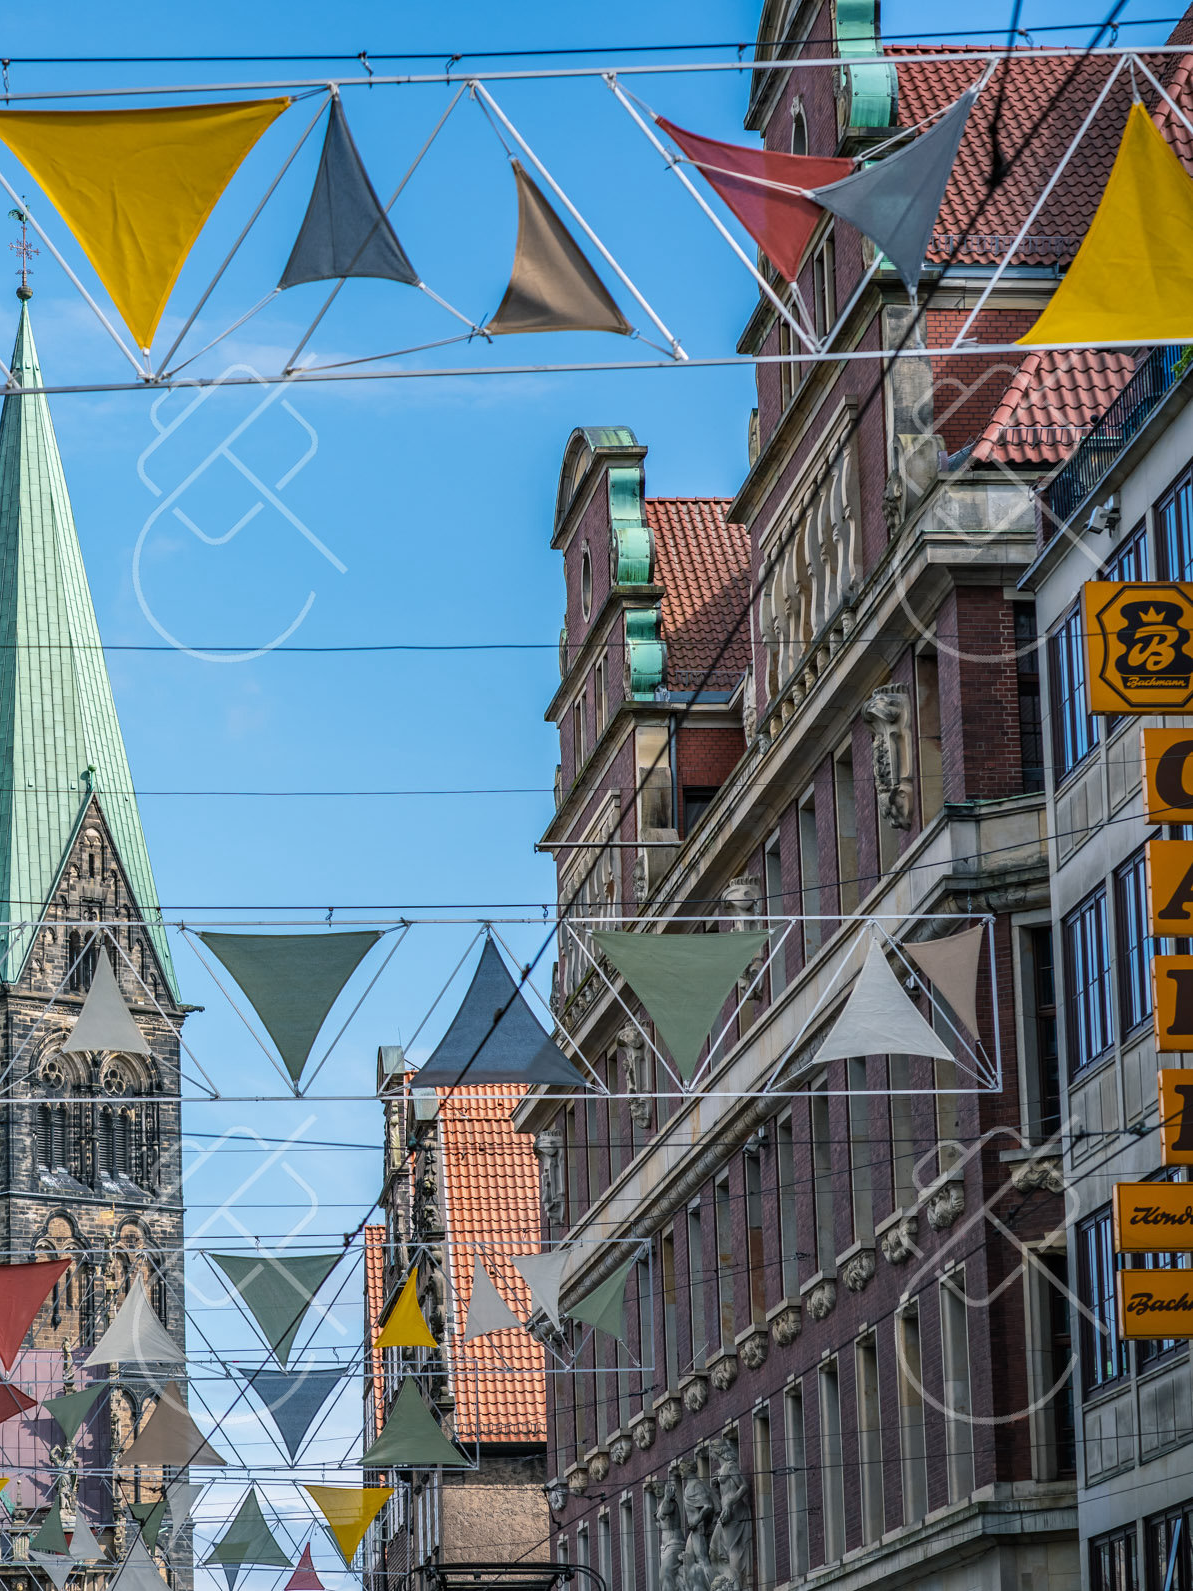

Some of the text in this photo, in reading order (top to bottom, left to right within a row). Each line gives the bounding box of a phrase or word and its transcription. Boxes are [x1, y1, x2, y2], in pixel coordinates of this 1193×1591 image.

[1127, 625, 1180, 672] B
[1127, 676, 1187, 688] Bachmann
[1130, 1206, 1193, 1226] Kond
